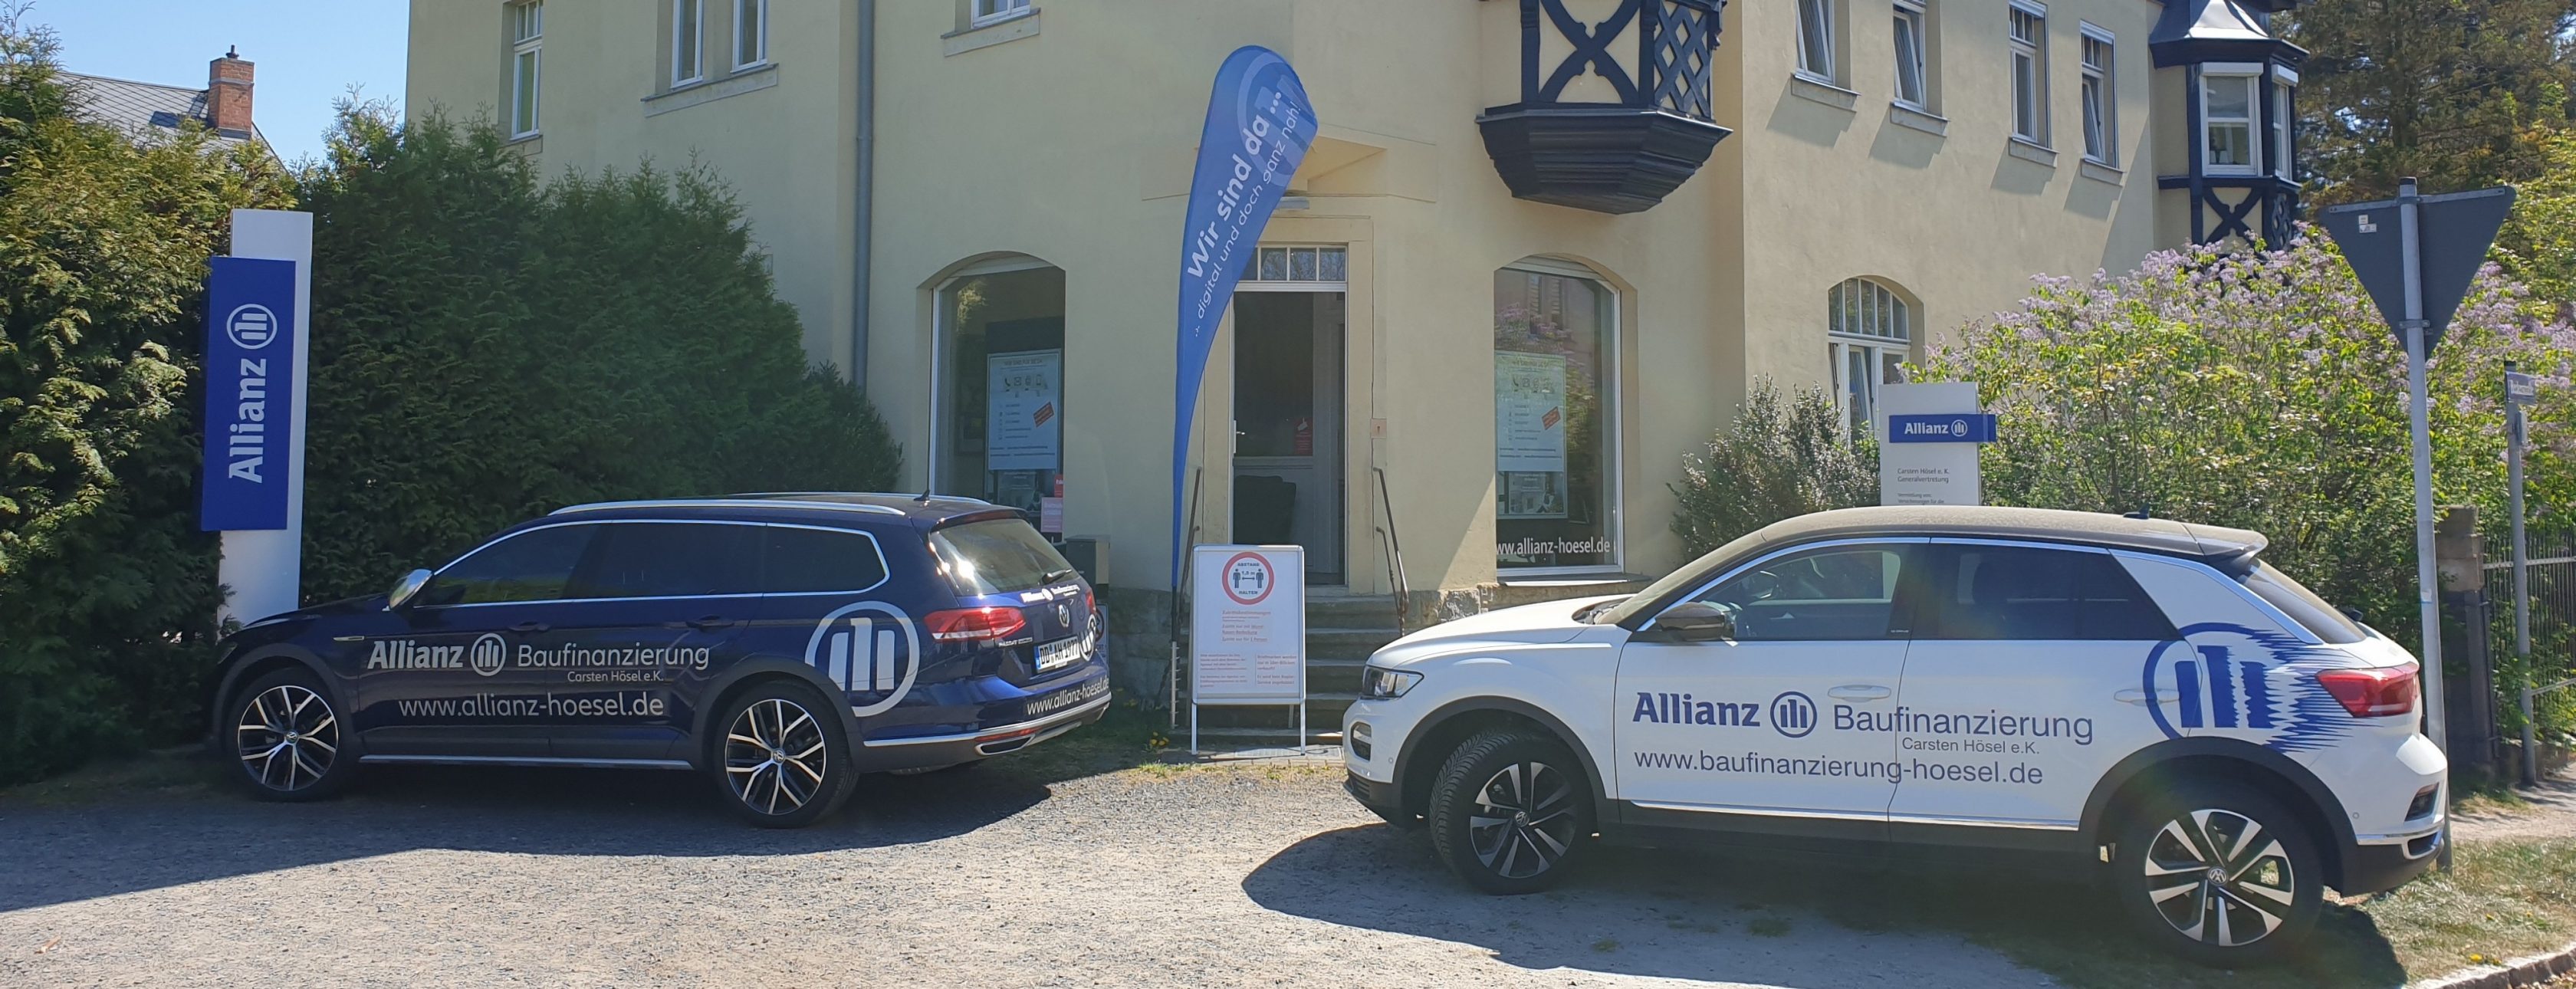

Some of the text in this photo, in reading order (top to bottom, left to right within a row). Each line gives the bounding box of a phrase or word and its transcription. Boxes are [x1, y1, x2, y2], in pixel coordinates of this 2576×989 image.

[1188, 221, 1219, 278] Wir
[1217, 153, 1252, 222] sind
[1243, 114, 1270, 155] da
[1198, 263, 1222, 319] digital
[1220, 225, 1240, 262] und
[1239, 185, 1263, 225] doch
[1263, 140, 1286, 184] ganz
[1282, 101, 1301, 140] nah!
[229, 358, 266, 484] Allianz
[1904, 422, 1949, 435] Allianz
[1898, 475, 1949, 484] Generalvertretung
[367, 639, 710, 671] Allianz Baufinanzierung
[1040, 646, 1050, 665] DD
[1054, 642, 1063, 662] AH
[567, 670, 664, 682] Carsten Hösel e.K.
[399, 692, 664, 716] www.allianz-hoesel.de
[1027, 674, 1109, 715] www.allianz-hoesel.de
[1632, 692, 2093, 745] Allianz Baufinanzierung
[1902, 737, 2040, 754] Carsten Hösel e.K.
[1634, 750, 2043, 784] www.baufinanzierung-hoesel.de
